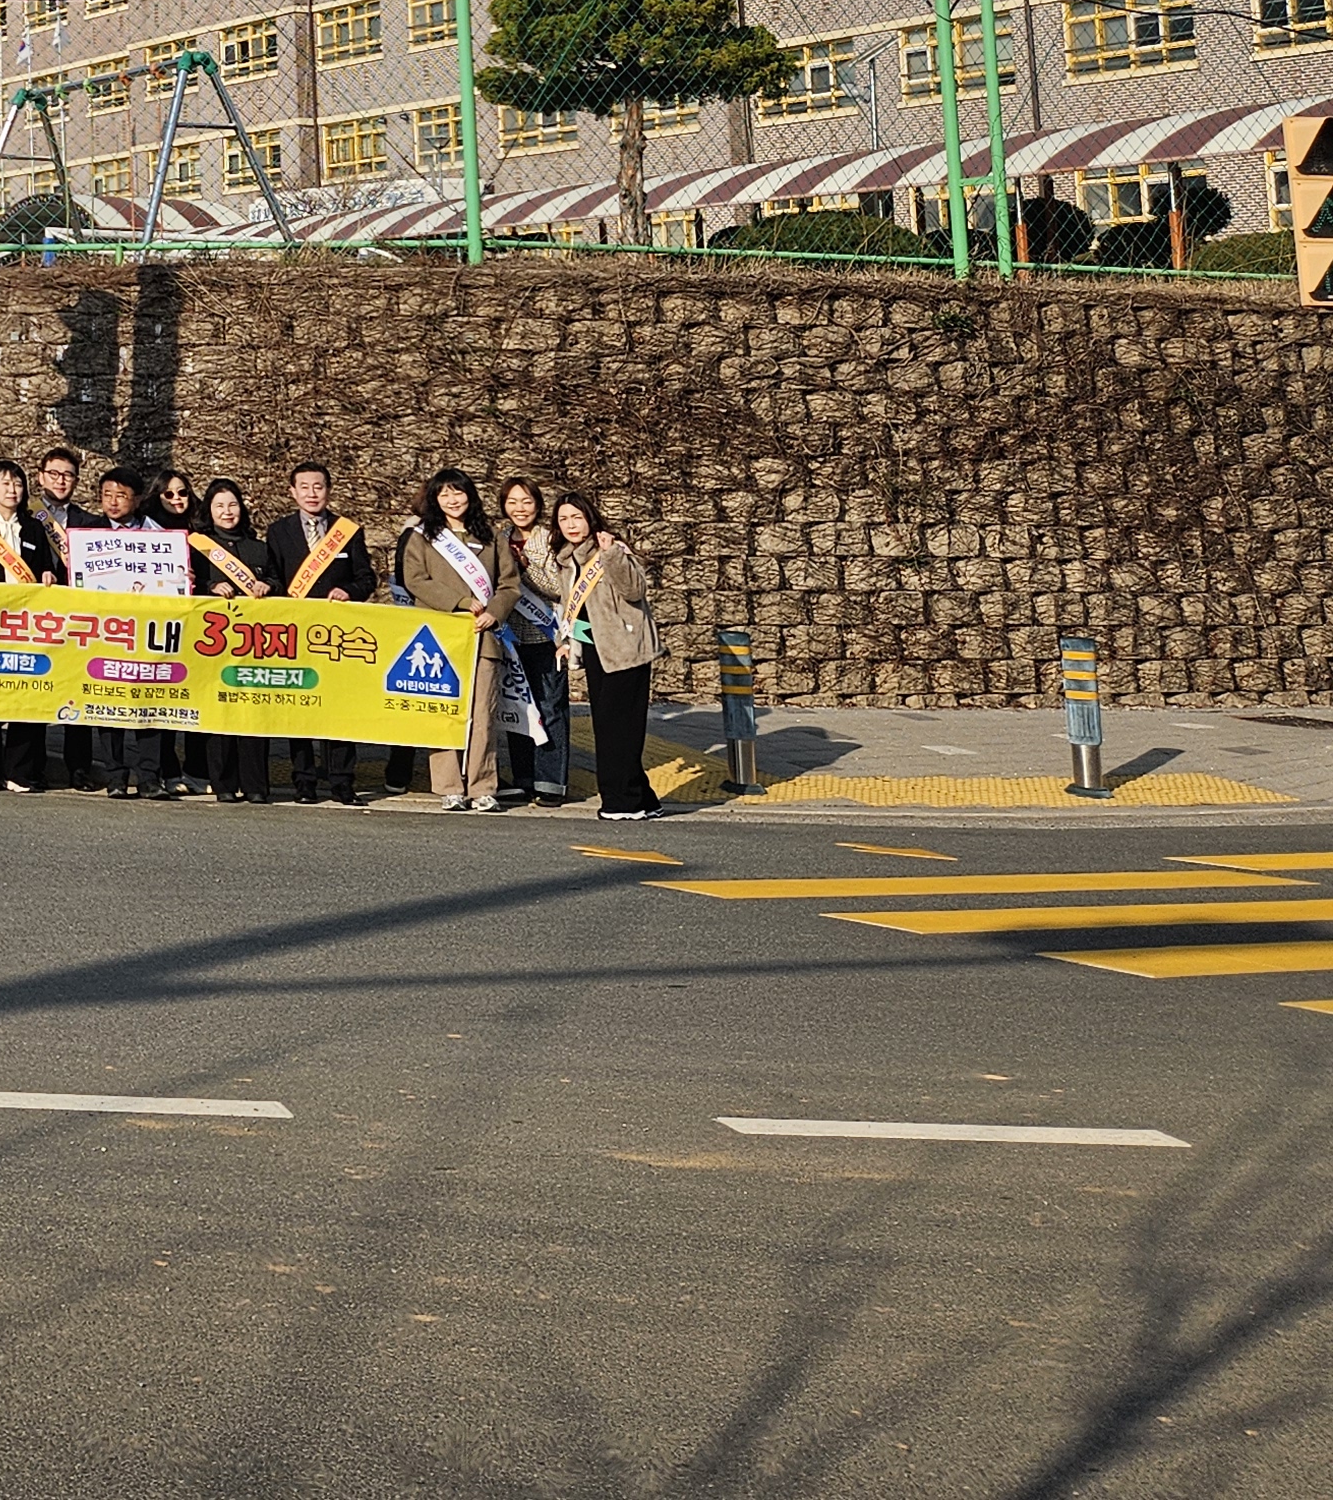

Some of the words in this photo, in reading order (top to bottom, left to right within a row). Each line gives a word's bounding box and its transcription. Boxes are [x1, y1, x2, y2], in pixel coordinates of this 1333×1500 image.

[86, 538, 123, 552] 교통신호
[125, 542, 148, 554] 바로
[151, 543, 172, 554] 보고
[324, 528, 345, 552] 함께
[84, 558, 123, 573] 횡단보도
[125, 562, 148, 573] 바로
[153, 562, 174, 574] 걷기
[148, 621, 181, 653] 내
[194, 611, 297, 660] 3가지
[307, 624, 377, 663] 약속
[103, 661, 171, 681] 잠깐멈춤
[237, 669, 303, 686] 주차금지
[32, 679, 54, 692] 이하
[83, 683, 126, 698] 횡단보도
[131, 687, 141, 699] 앞
[144, 687, 166, 699] 잠깐
[169, 687, 190, 700] 멈춤
[395, 680, 452, 694] 어린이보호
[217, 691, 271, 704] 불법주정차
[275, 694, 295, 706] 하지
[300, 694, 322, 707] 않기
[384, 698, 459, 716] 초·중·고등학교
